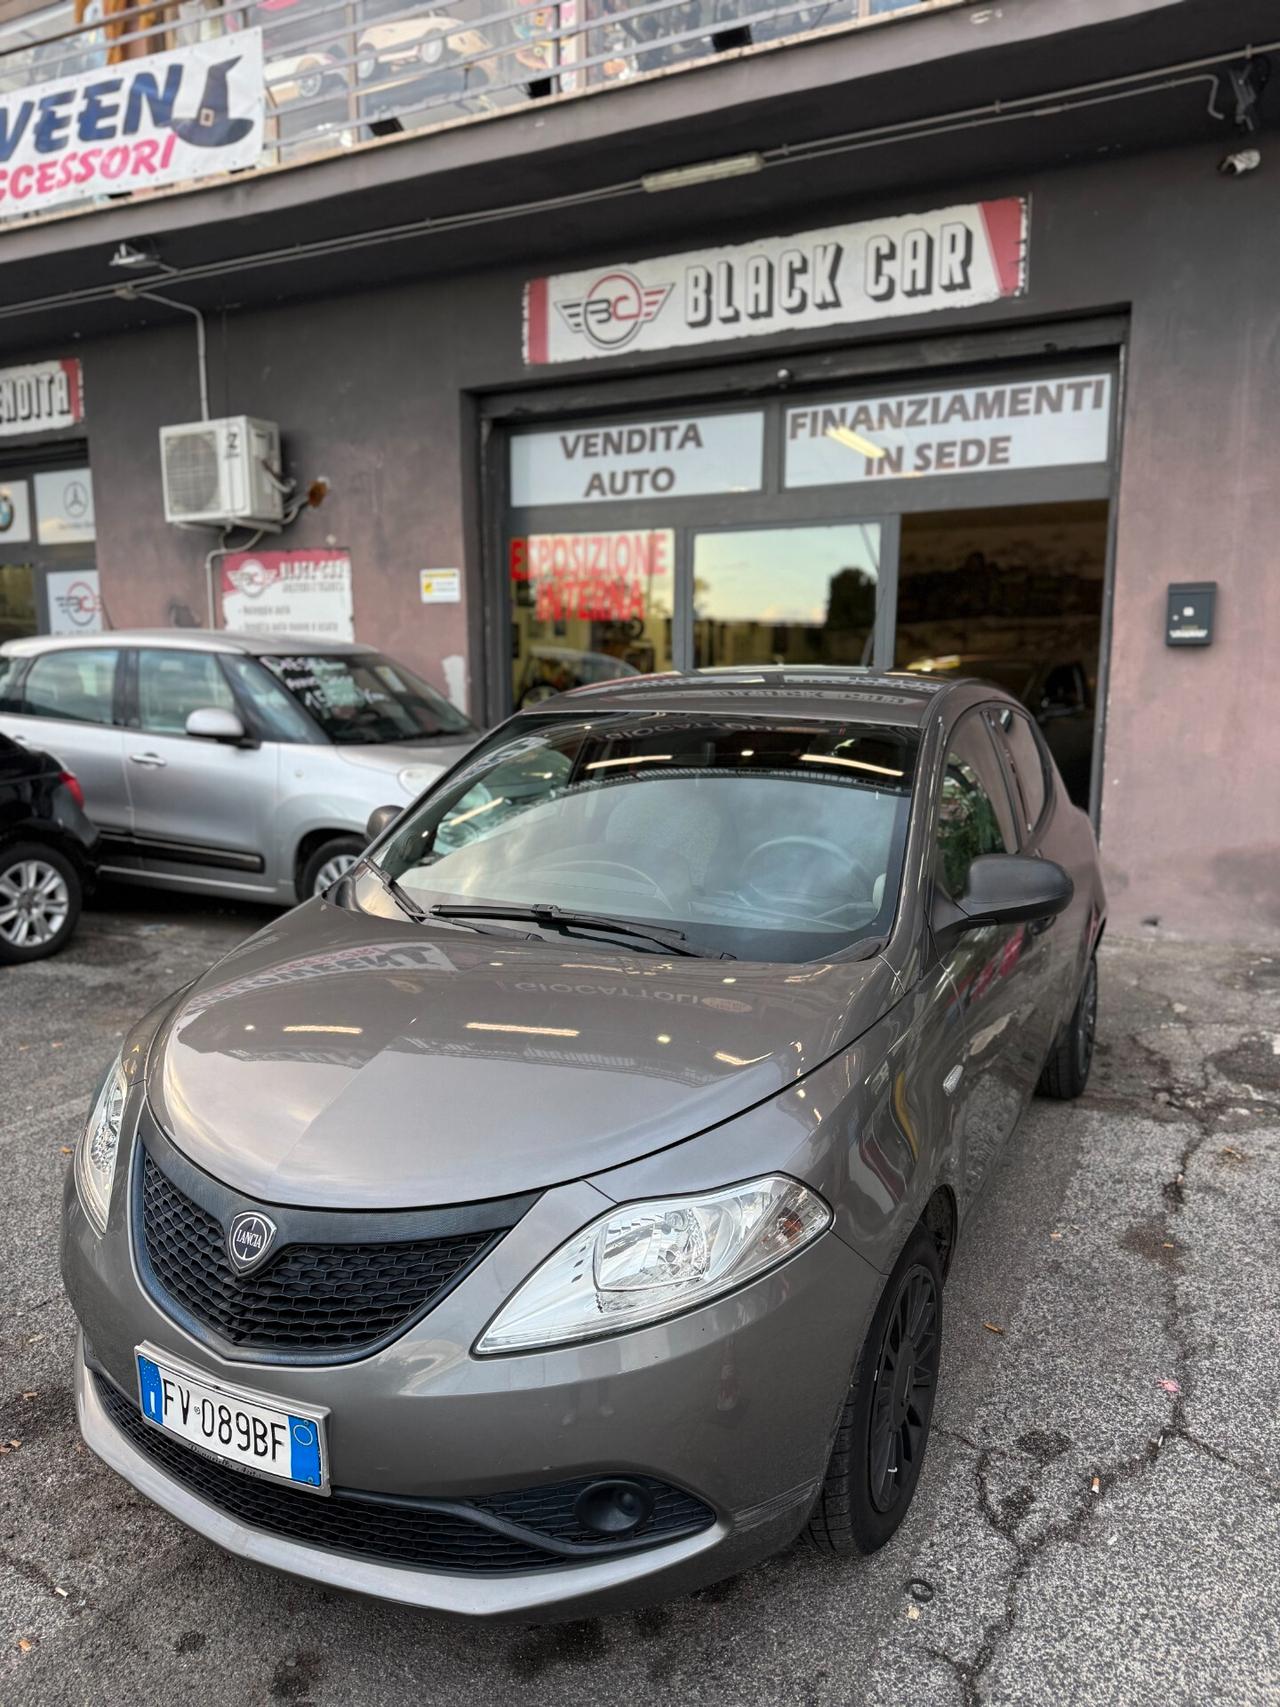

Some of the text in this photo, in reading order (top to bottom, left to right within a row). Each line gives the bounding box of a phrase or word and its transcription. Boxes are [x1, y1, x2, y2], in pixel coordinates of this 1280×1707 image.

[685, 222, 972, 328] BLACK CAR
[790, 380, 1105, 440] FINANZIAMENTI
[560, 423, 703, 460] VENDITA
[863, 436, 1012, 476] IN SEDE
[583, 467, 675, 498] AUTO
[236, 1230, 262, 1249] LANCIA
